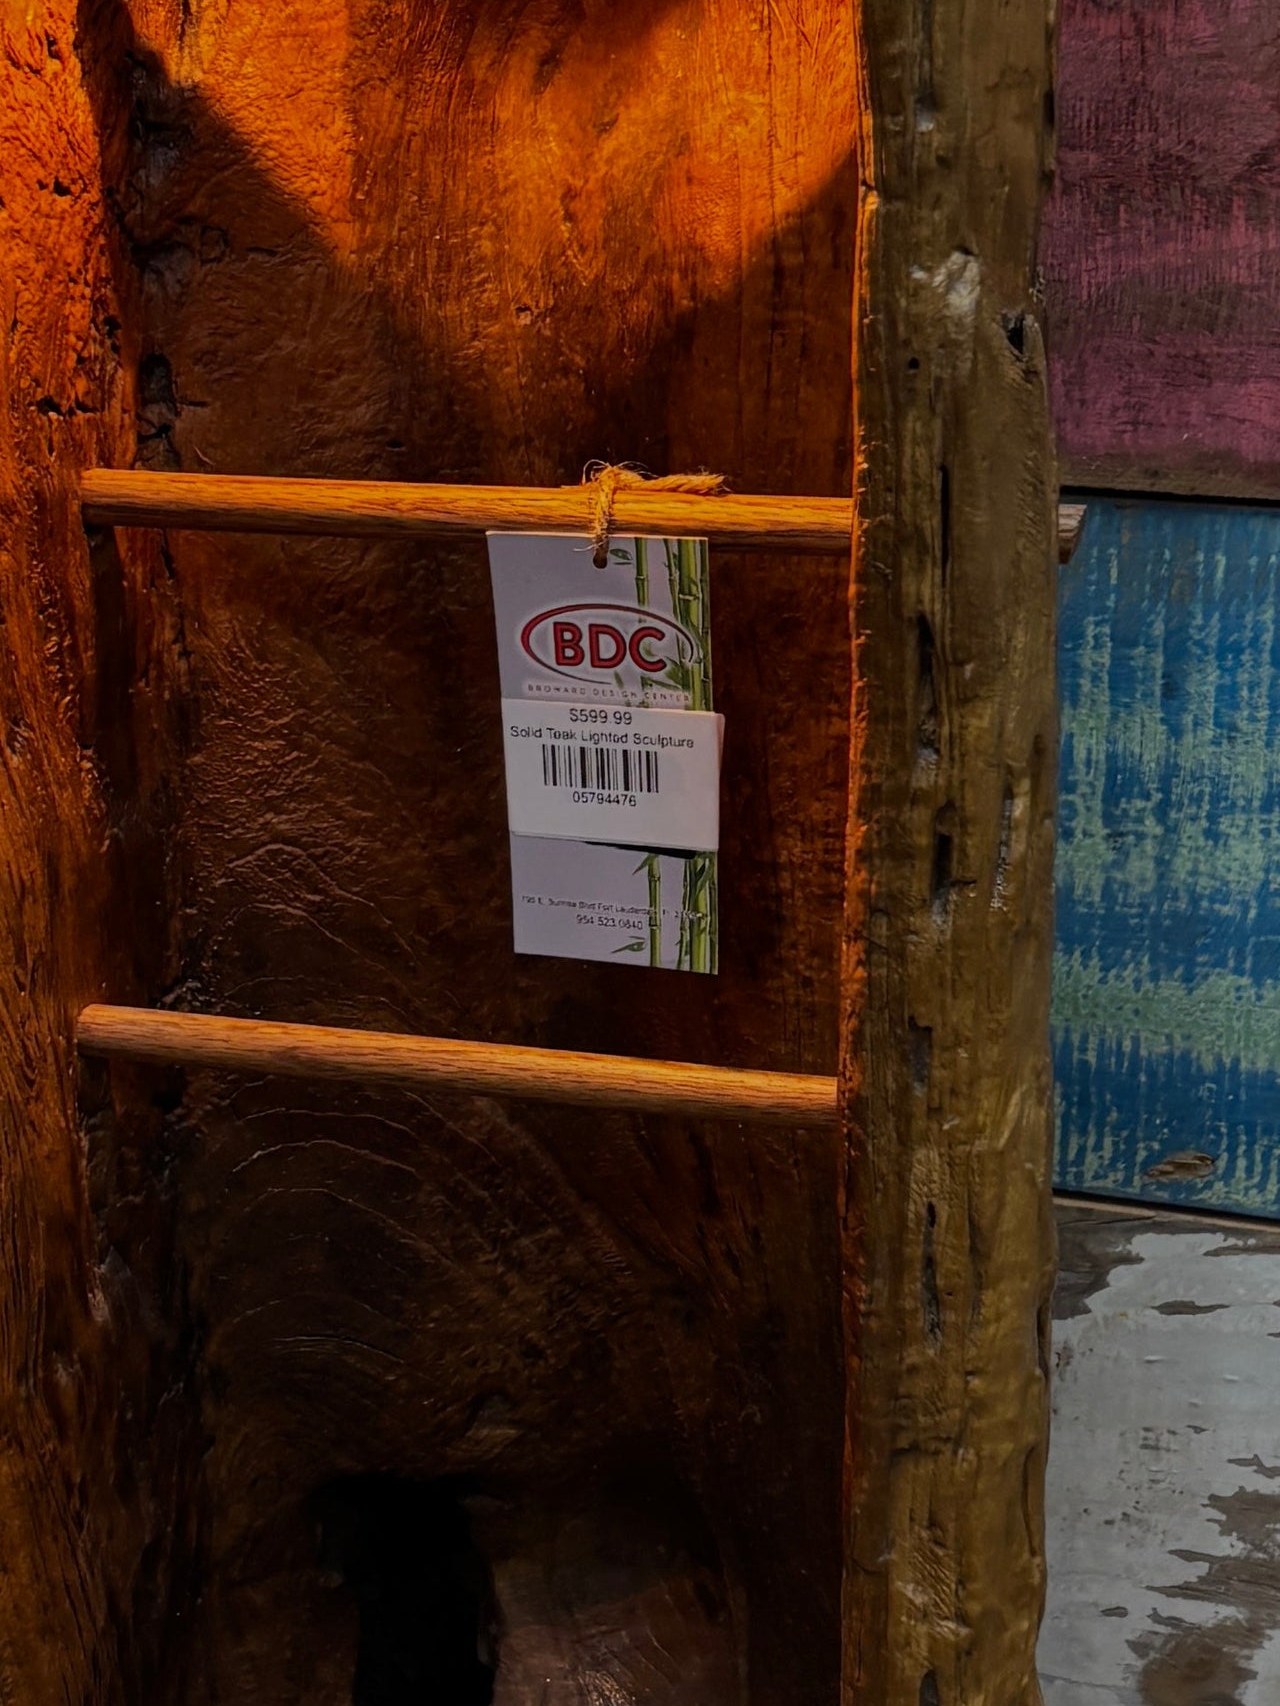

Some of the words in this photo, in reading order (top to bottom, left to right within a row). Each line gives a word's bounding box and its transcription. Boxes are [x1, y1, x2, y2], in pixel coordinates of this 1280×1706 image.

[552, 621, 668, 673] BDC
[527, 683, 587, 696] BROWARD
[592, 687, 637, 699] DESIGN
[644, 691, 690, 702] CENTER
[569, 708, 633, 725] $599.99
[510, 725, 542, 739] Solid
[547, 727, 577, 740] Teak
[581, 729, 628, 746] Lighted
[633, 732, 694, 750] Sculpture
[572, 792, 637, 807] 05794476
